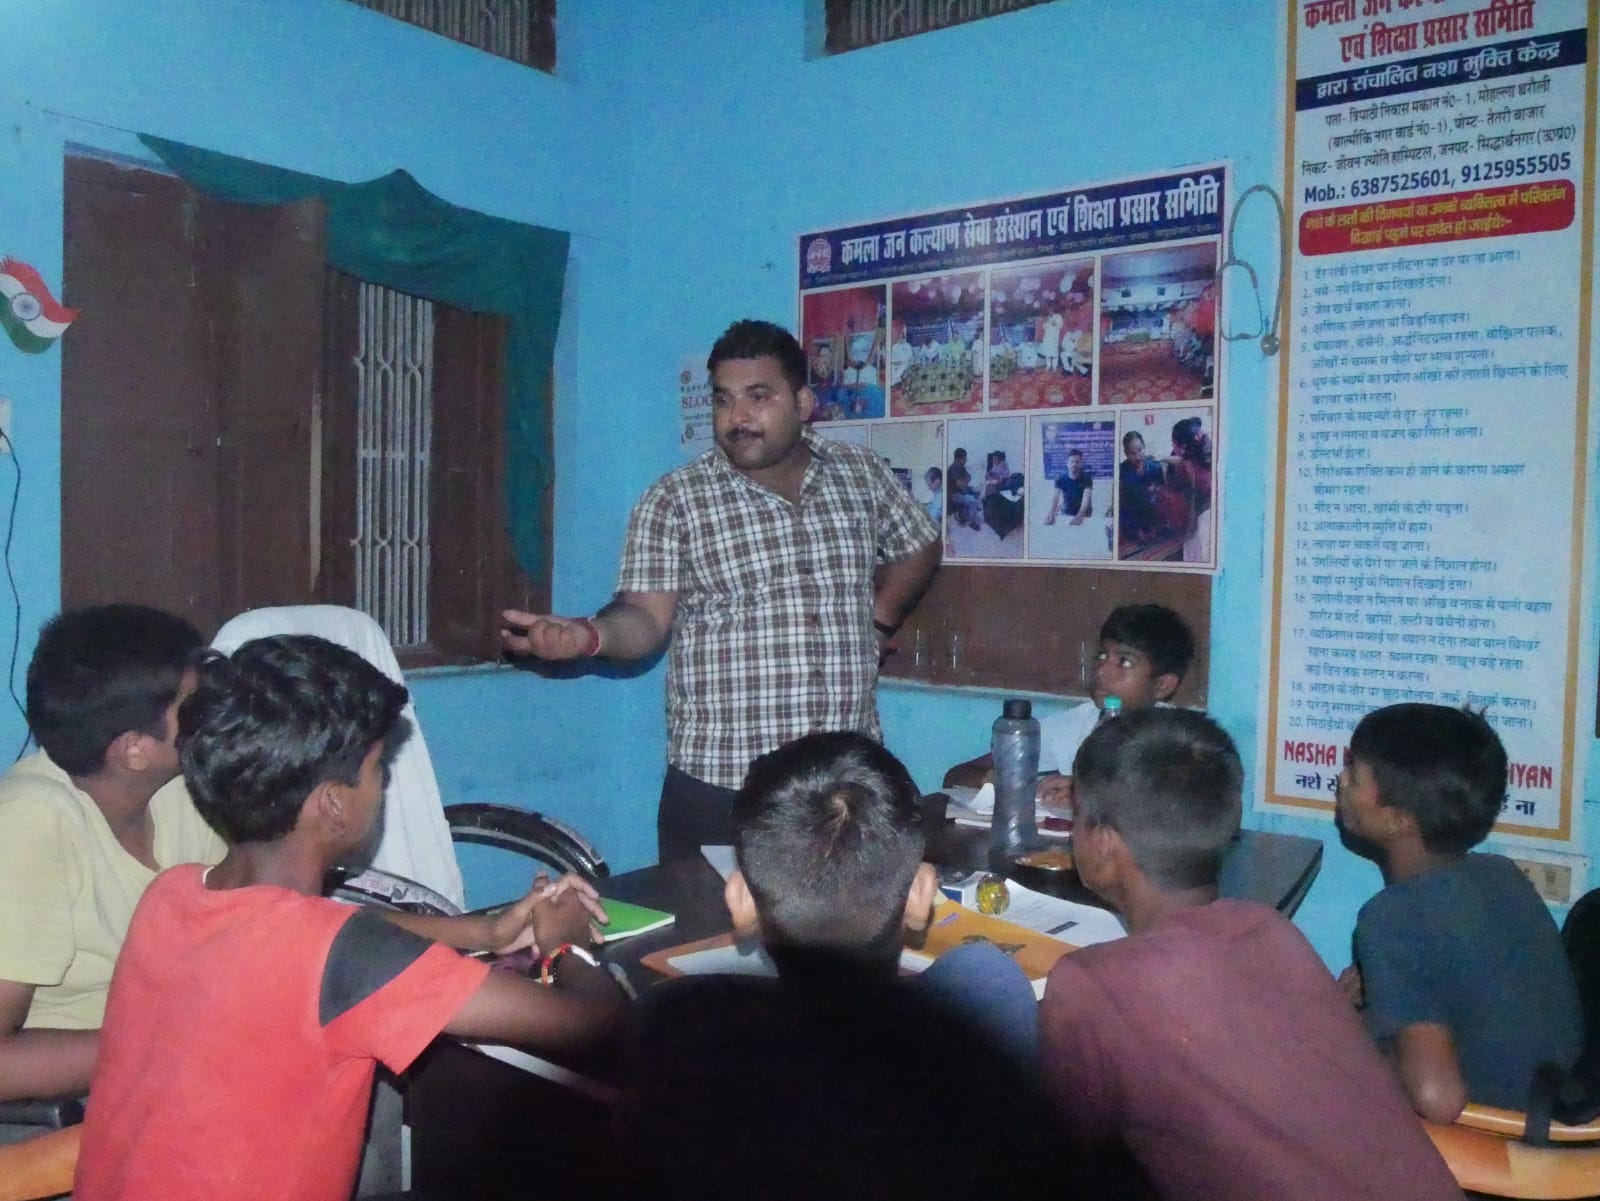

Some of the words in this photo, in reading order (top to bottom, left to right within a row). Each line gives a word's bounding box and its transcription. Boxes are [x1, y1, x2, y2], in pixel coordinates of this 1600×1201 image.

[1340, 24, 1368, 62] एवं
[1371, 22, 1418, 57] शिक्षा
[1423, 13, 1469, 48] प्रसार
[1473, 0, 1535, 37] समिति
[1317, 79, 1348, 99] द्वारा
[1352, 65, 1418, 91] संचालित
[1422, 59, 1458, 78] नशा
[1463, 47, 1513, 79] मुक्ति
[1517, 40, 1561, 62] केन्द्र
[1374, 129, 1393, 142] नगर
[1512, 105, 1546, 121] बाजार
[1380, 102, 1409, 118] निवास
[1412, 97, 1440, 112] मकान
[1478, 84, 1516, 102] मोहल्ला
[1335, 154, 1361, 170] जीवन
[1362, 149, 1389, 166] ज्योति
[1477, 129, 1536, 152] सिद्धार्थनगर
[1305, 184, 1345, 203] Mob.:
[1351, 168, 1455, 198] 6387525601,
[1462, 152, 1571, 183] 9125955505
[841, 235, 880, 265] कमला
[884, 230, 906, 259] जन
[909, 222, 960, 255] कल्याण
[964, 213, 991, 248] सेवा
[995, 208, 1043, 243] संस्थान
[1047, 197, 1070, 237] एवं
[1074, 194, 1115, 233] शिक्षा
[1120, 191, 1161, 227] प्रसार
[1165, 175, 1220, 220] समिति
[1410, 225, 1424, 238] पर
[1284, 740, 1337, 767] NASHA
[1508, 762, 1553, 790] IYAN
[1295, 772, 1322, 790] नशे
[1515, 799, 1537, 816] ना
